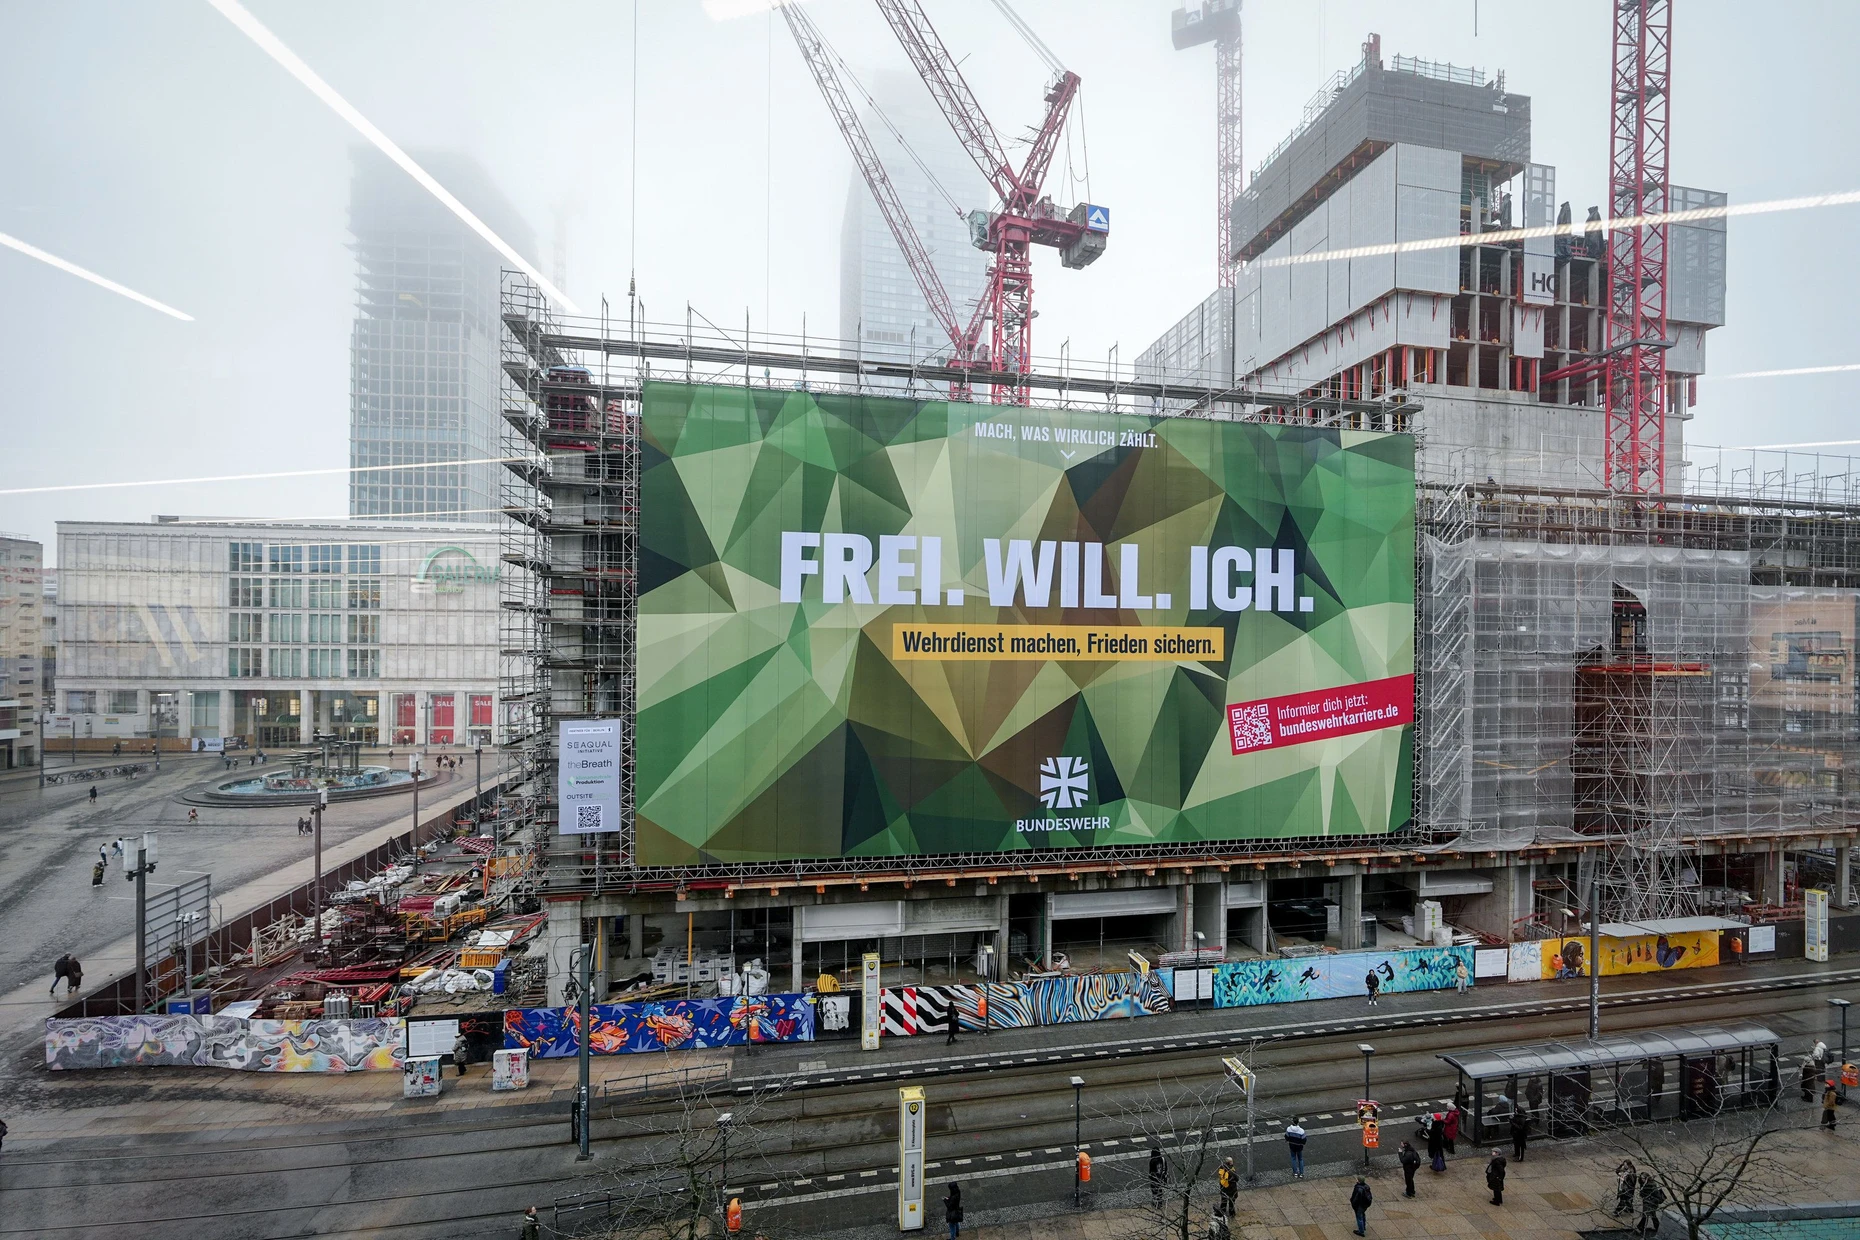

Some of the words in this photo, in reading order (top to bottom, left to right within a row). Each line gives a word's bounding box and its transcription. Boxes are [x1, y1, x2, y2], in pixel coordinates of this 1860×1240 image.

[974, 422, 1017, 442] MACH,
[1021, 426, 1050, 442] WAS
[1054, 427, 1115, 446] WIRKLICH
[1119, 429, 1158, 448] ZÄHLT.
[431, 565, 500, 585] GALERIA
[780, 531, 964, 606] FREI.
[983, 538, 1171, 610] WILL.
[1190, 545, 1314, 613] ICH.
[902, 630, 1004, 653] Wehrdienst
[1010, 632, 1081, 657] machen,
[1087, 632, 1148, 654] Frieden
[1153, 633, 1216, 655] sichern.
[1277, 702, 1320, 720] Informier
[1322, 697, 1343, 712] dich
[1344, 693, 1369, 711] jetzt:
[1279, 703, 1399, 737] bundeswehrkarriere.de
[567, 741, 613, 749] SEAQUAL
[567, 759, 613, 769] theBreath
[1016, 816, 1111, 832] BUNDESWEHR
